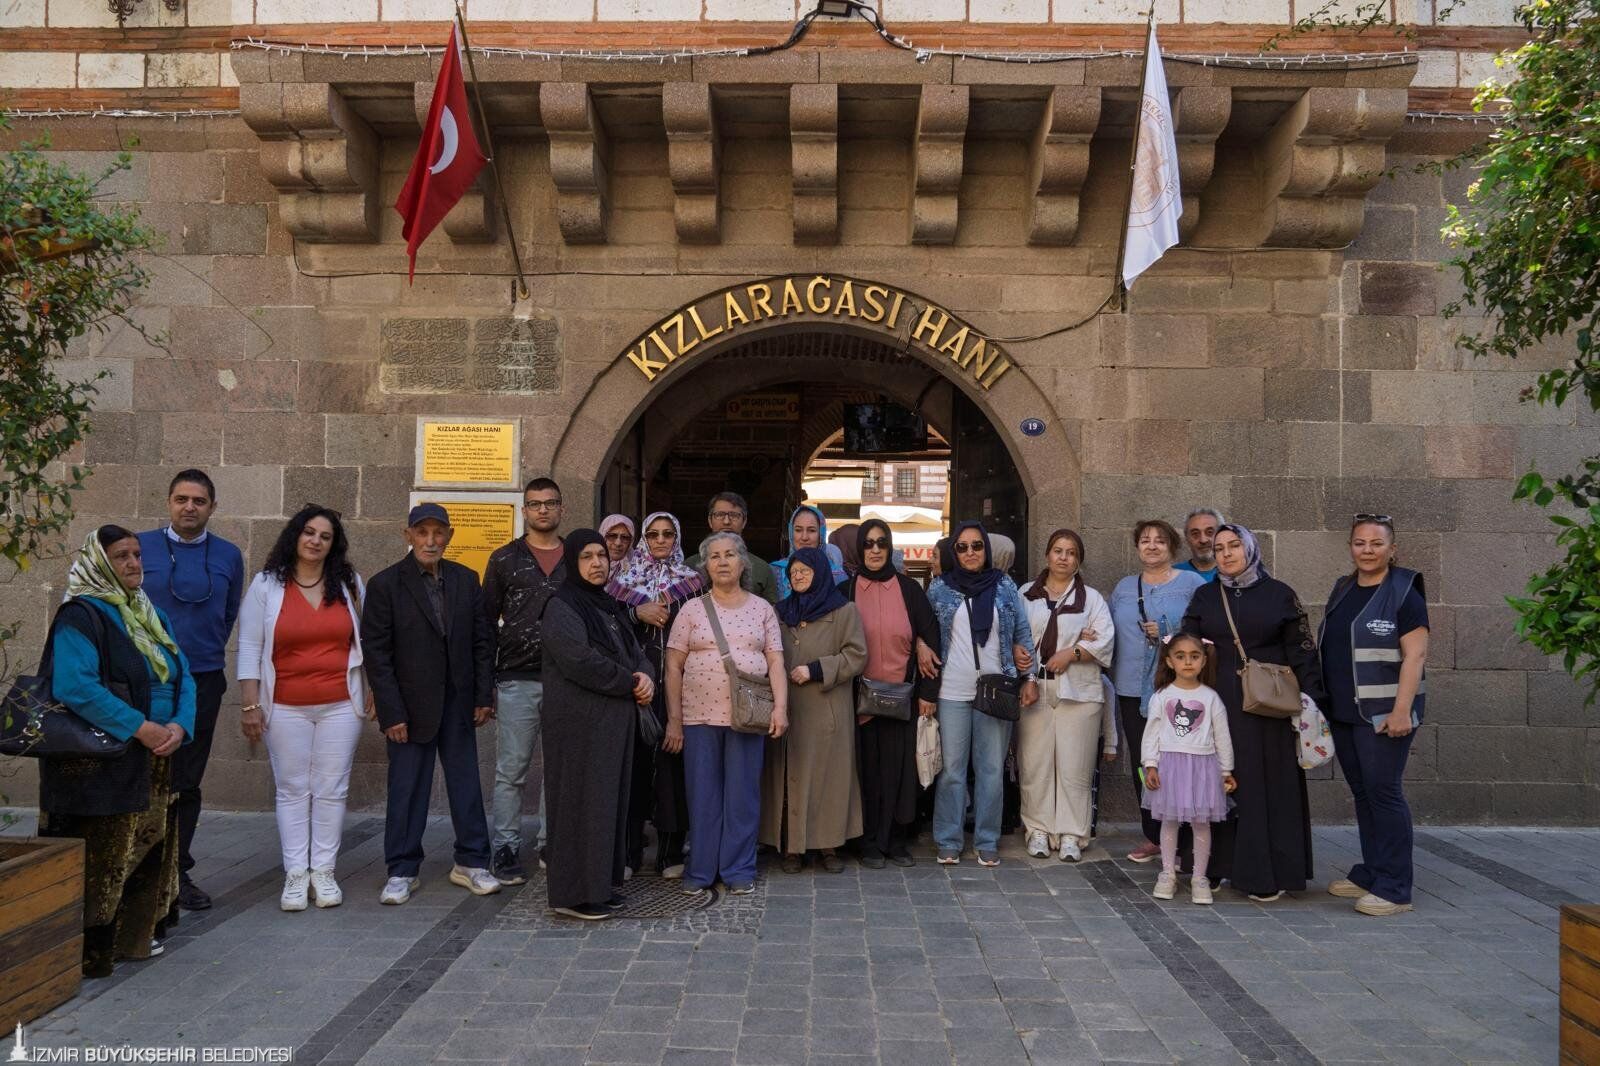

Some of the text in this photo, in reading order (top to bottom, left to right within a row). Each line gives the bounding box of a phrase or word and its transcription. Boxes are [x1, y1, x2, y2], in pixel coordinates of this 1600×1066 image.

[626, 276, 905, 382] KIZLARAĞASI
[911, 305, 1012, 390] HANI
[1029, 422, 1038, 431] 19
[903, 547, 933, 558] HVE
